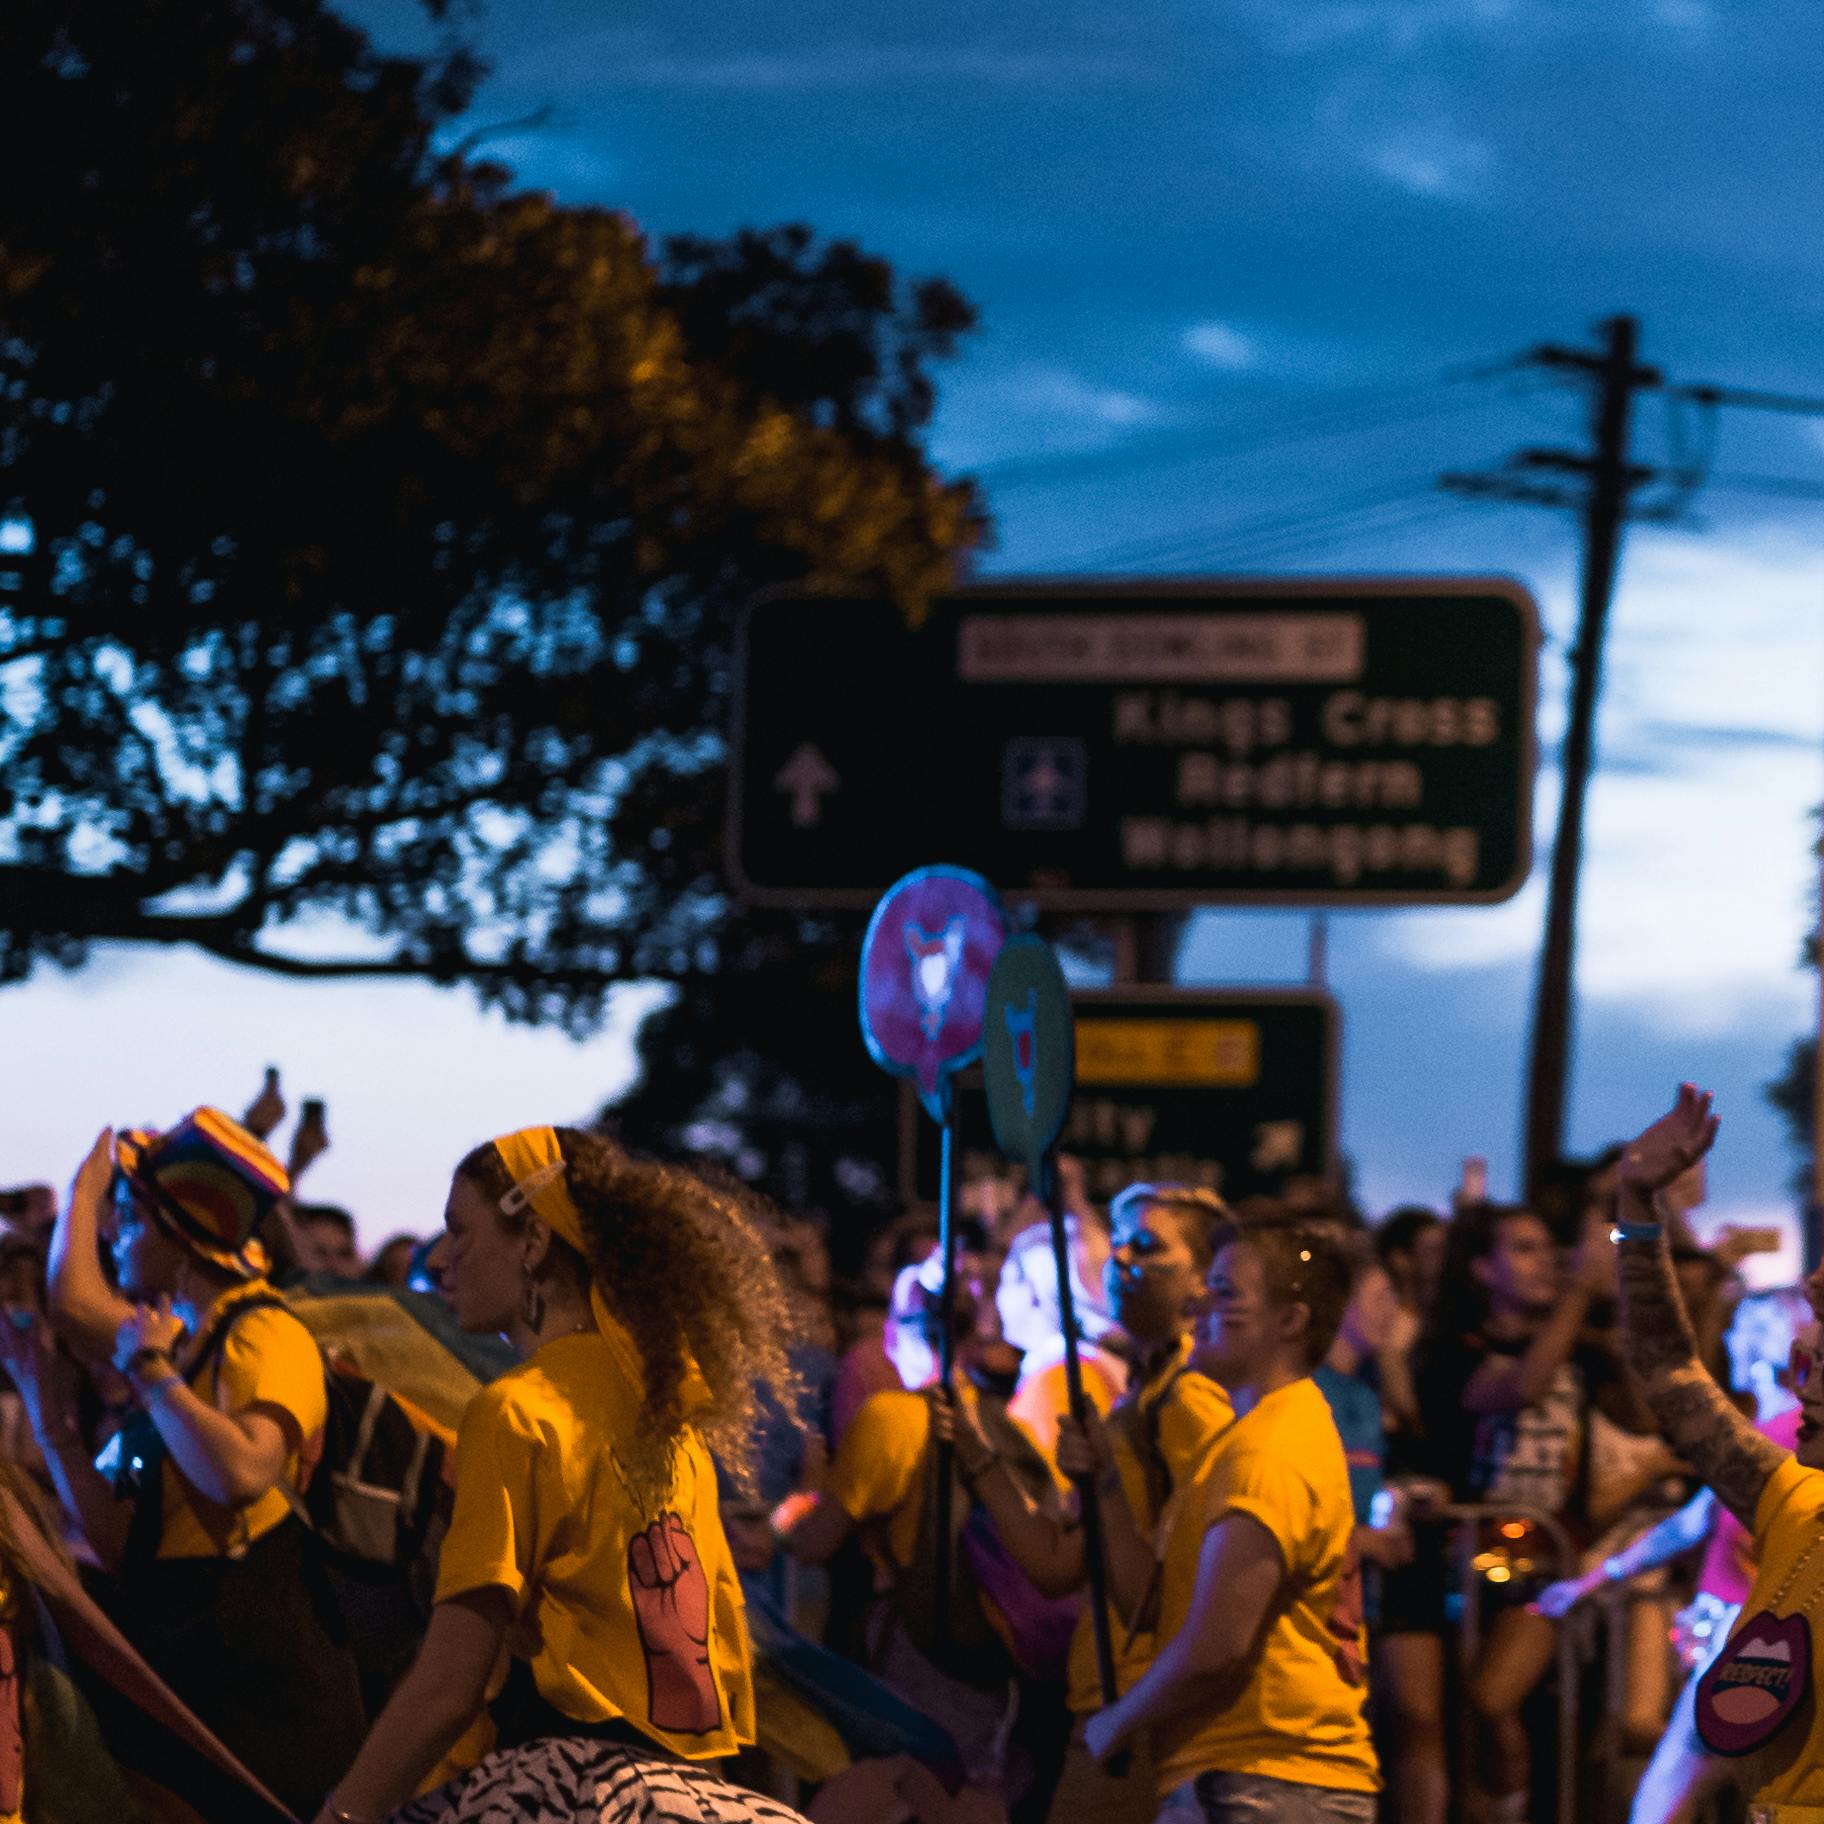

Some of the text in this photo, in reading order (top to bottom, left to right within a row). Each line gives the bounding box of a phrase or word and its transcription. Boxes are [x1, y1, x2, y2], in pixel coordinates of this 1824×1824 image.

[1114, 690, 1498, 754] Kings Cross
[1177, 752, 1422, 809] Redfern
[1122, 817, 1478, 886] Wollongong
